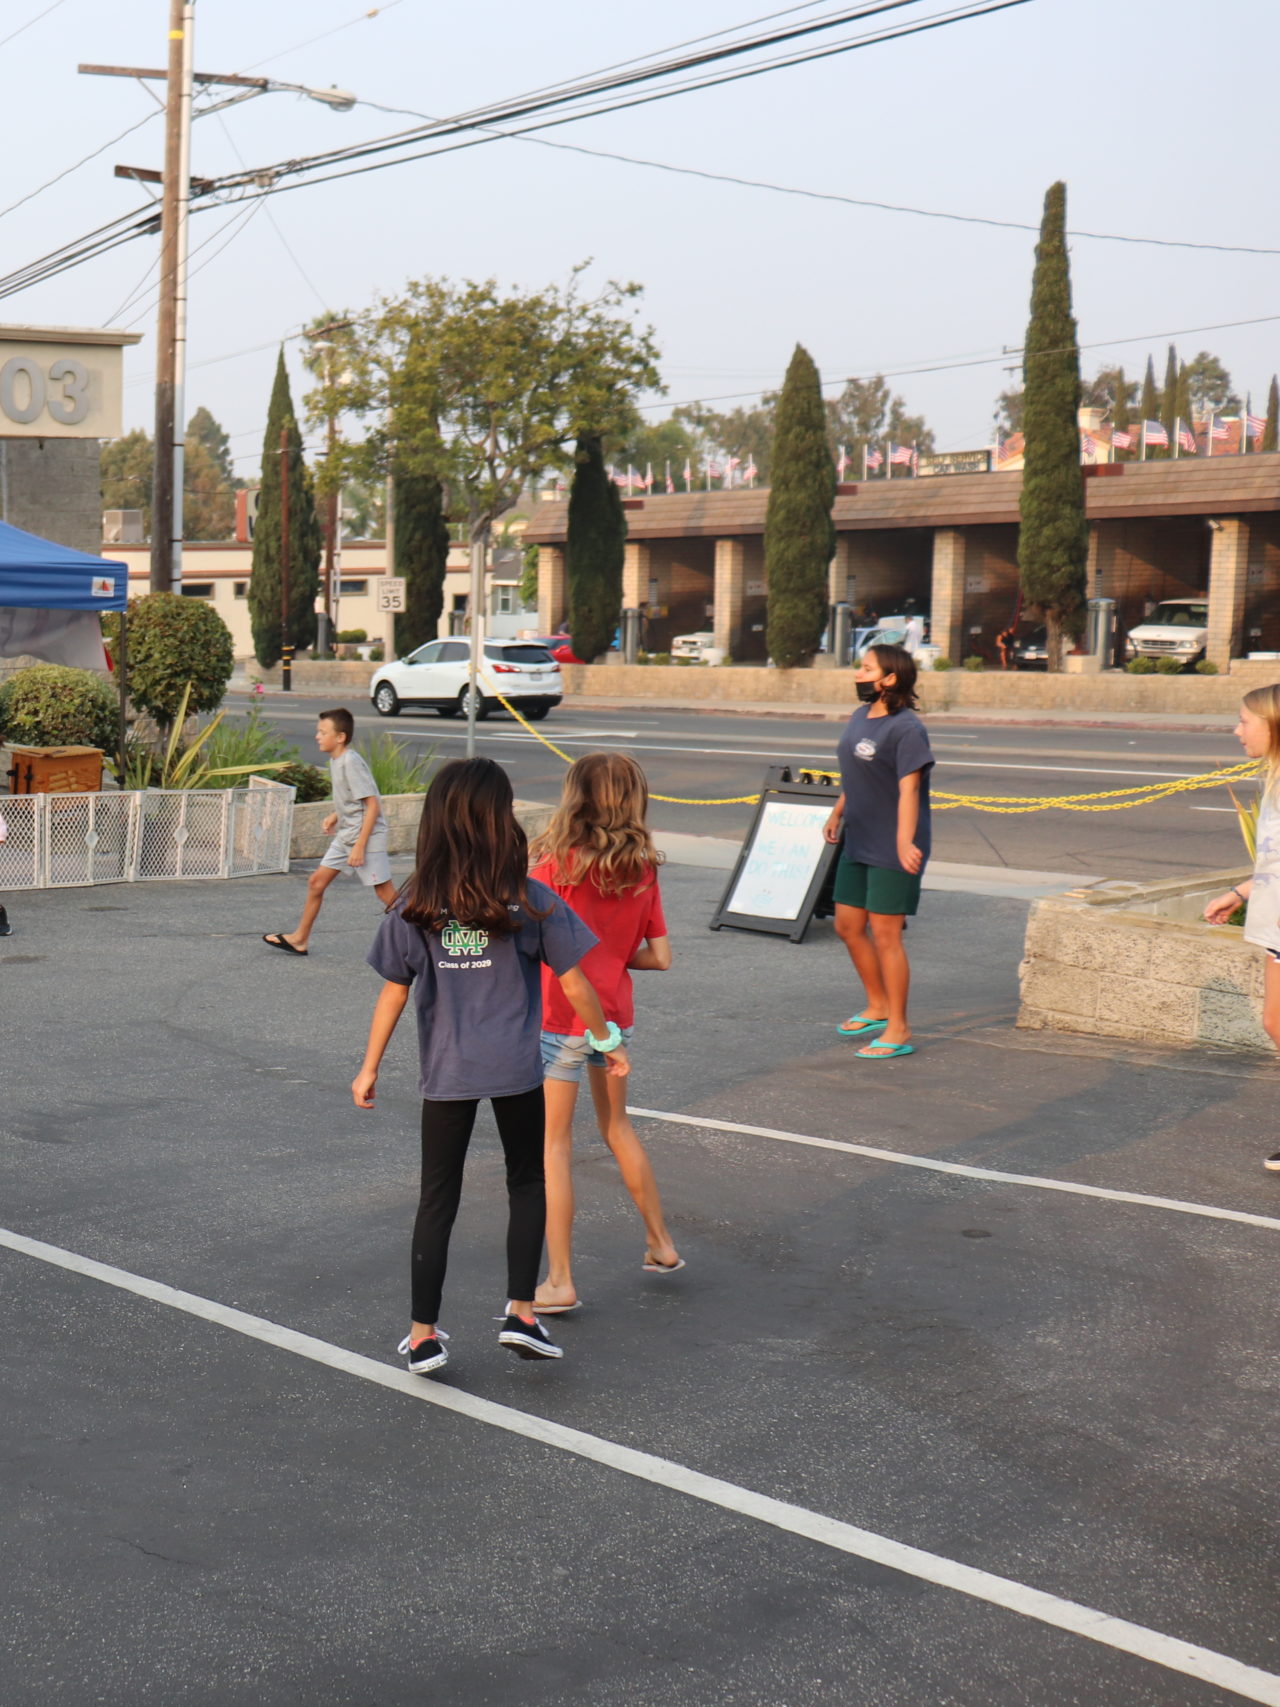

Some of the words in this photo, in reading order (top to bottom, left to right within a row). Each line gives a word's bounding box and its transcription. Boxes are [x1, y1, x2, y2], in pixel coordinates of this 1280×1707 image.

[381, 595, 401, 608] 35
[768, 810, 826, 829] WELCOM
[438, 960, 459, 969] Class
[460, 960, 469, 969] of
[471, 959, 492, 968] 2029
